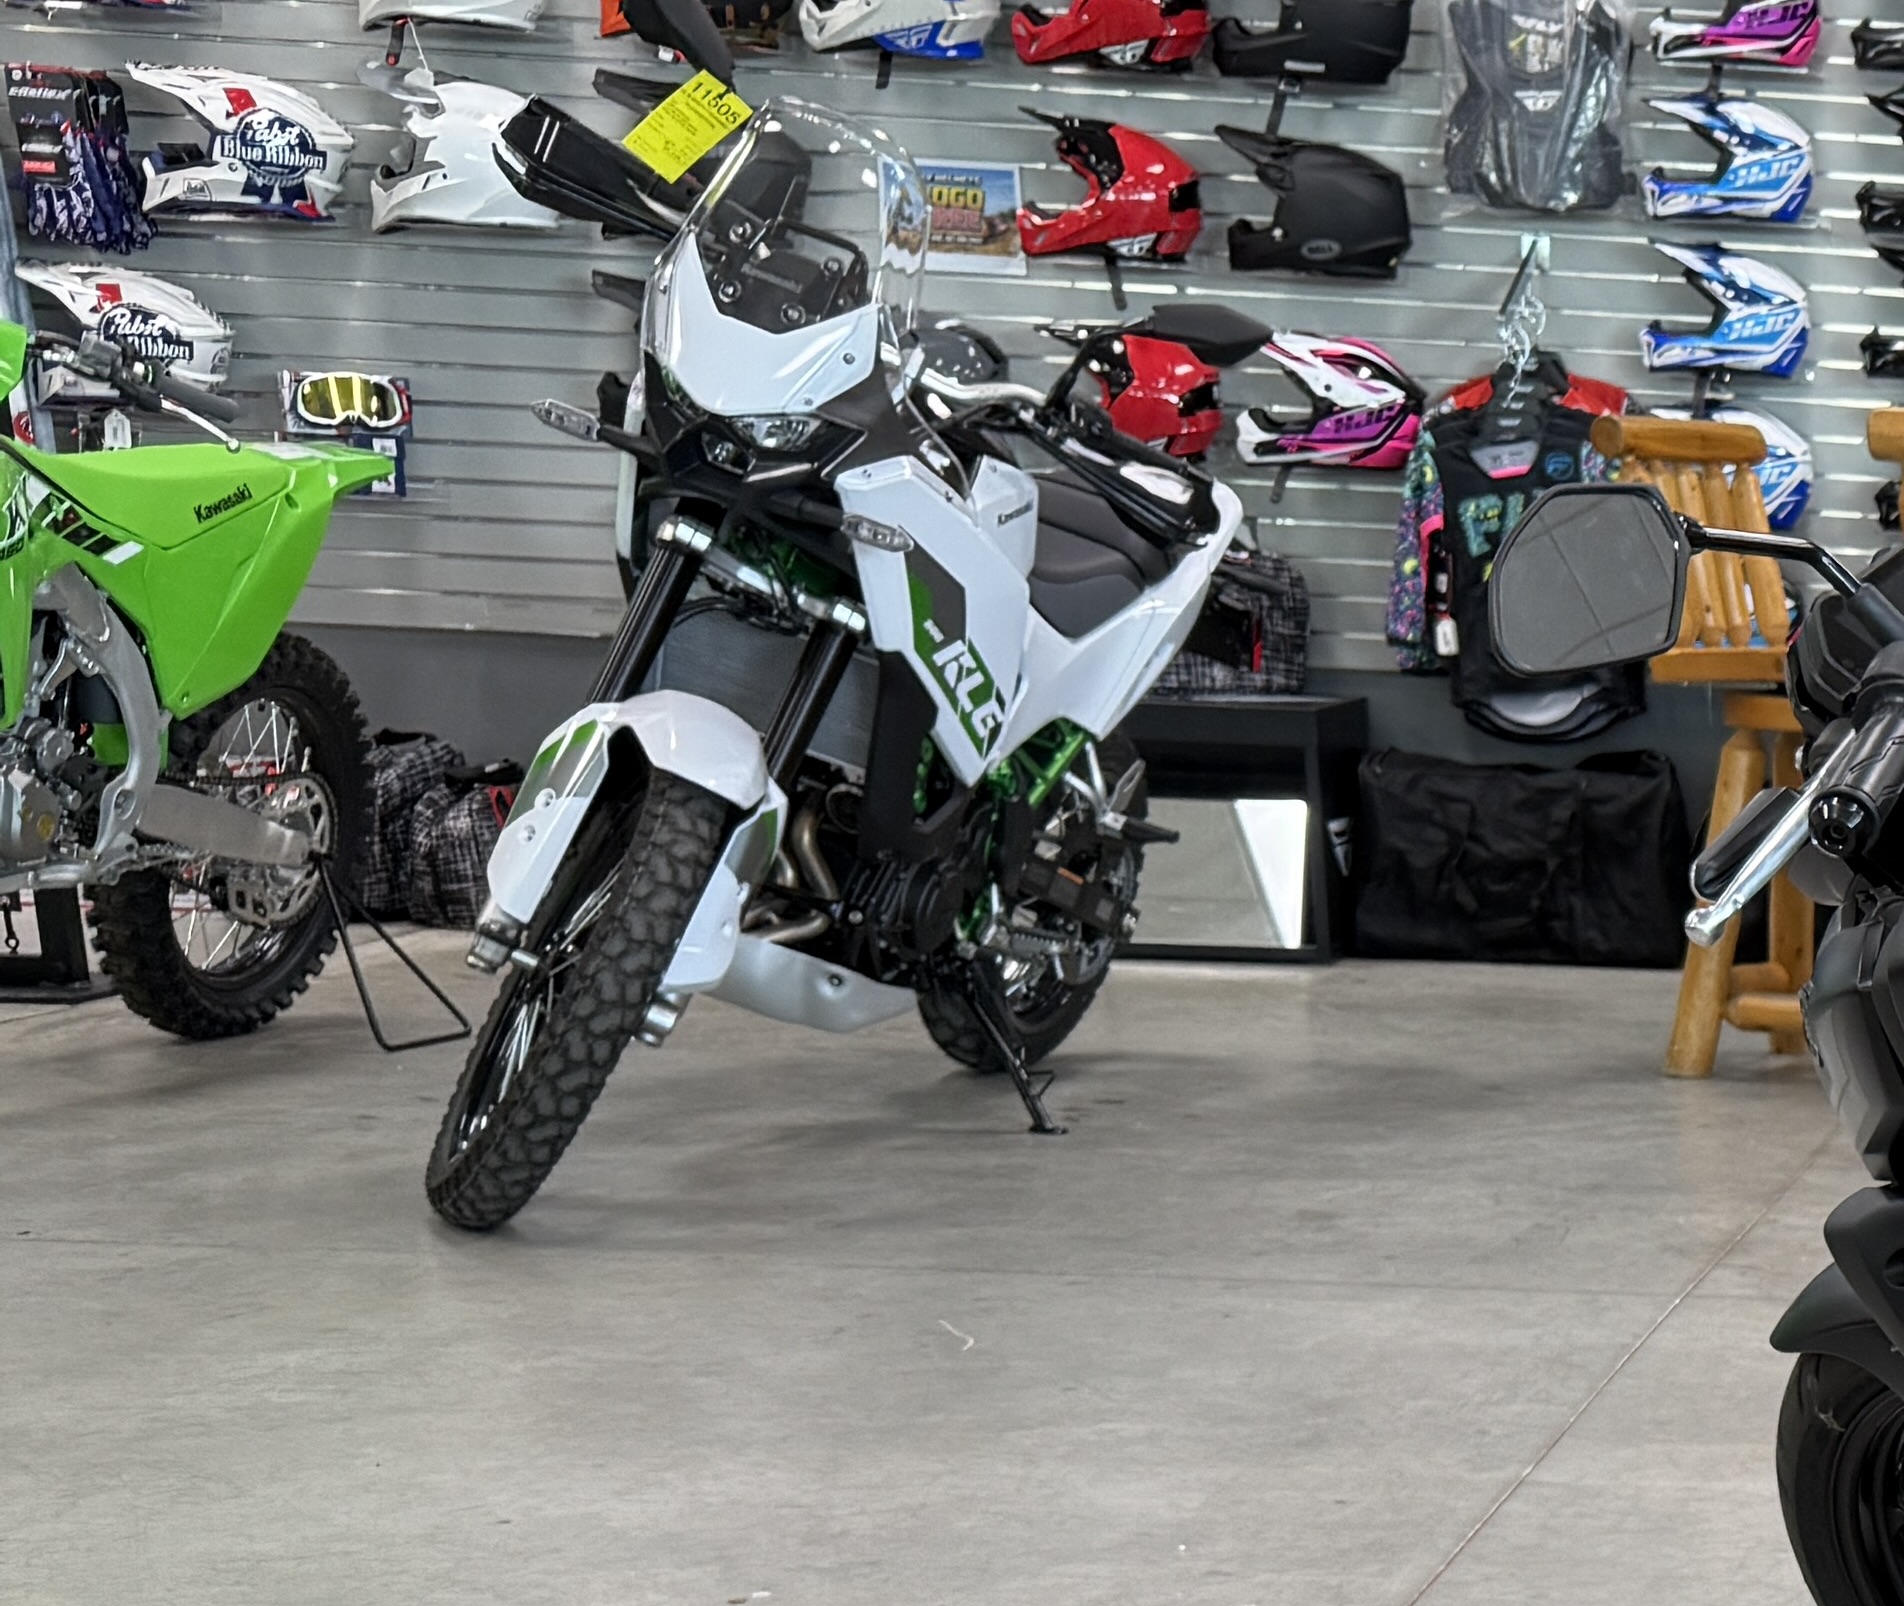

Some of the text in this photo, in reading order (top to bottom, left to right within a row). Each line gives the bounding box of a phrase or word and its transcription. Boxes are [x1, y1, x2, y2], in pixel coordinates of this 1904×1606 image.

[1745, 2, 1811, 28] HJC
[691, 81, 741, 126] 11505
[243, 110, 301, 148] Pabst
[222, 135, 325, 170] Blue Ribbon
[1742, 159, 1801, 188] HJC
[1730, 313, 1796, 342] HJC
[1333, 406, 1397, 433] HJC
[193, 483, 253, 524] Kawasaki
